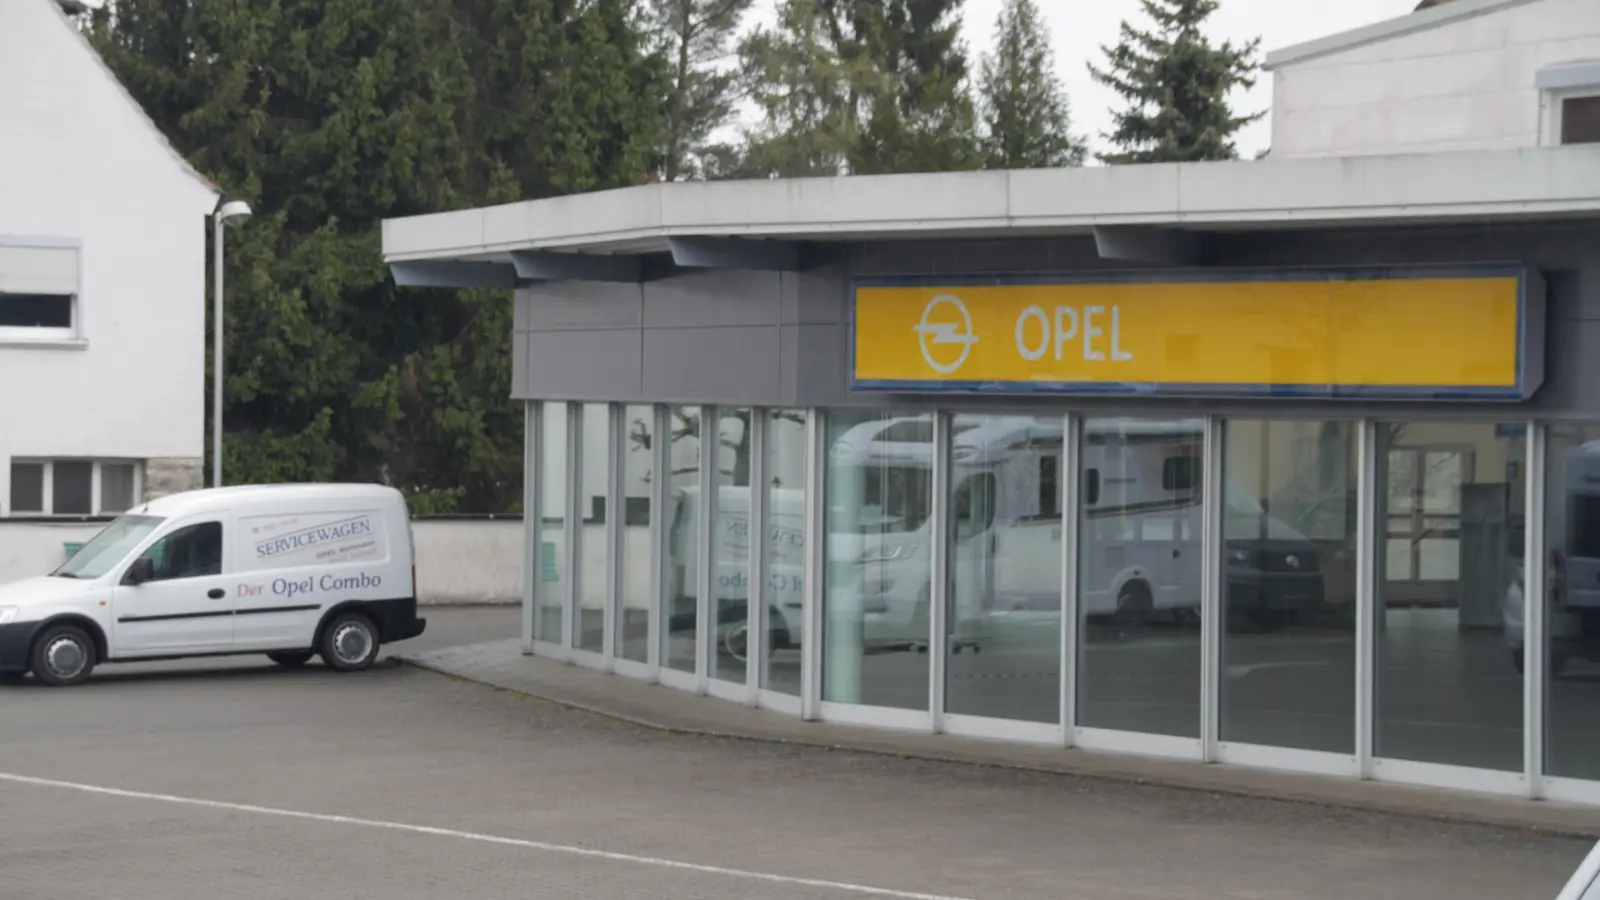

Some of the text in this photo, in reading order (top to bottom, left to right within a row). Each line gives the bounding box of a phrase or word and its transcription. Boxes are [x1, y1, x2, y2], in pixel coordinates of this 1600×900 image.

[1014, 304, 1134, 361] OPEL
[256, 519, 371, 558] SERVICEWAGEN
[237, 571, 382, 597] Der Opel Combo
